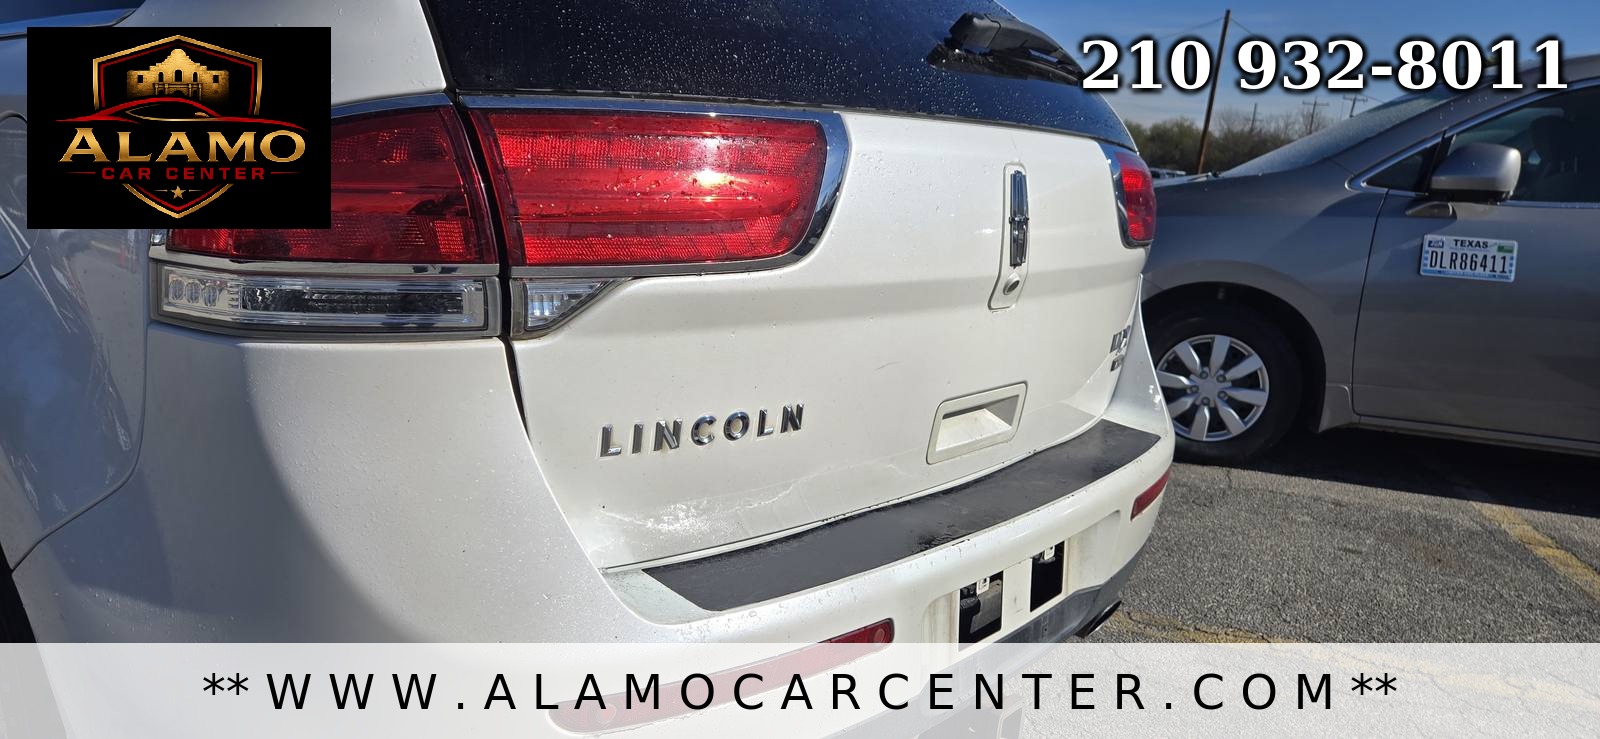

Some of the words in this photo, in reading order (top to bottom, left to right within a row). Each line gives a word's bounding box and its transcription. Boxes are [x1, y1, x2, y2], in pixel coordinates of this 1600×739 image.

[1453, 239, 1489, 249] TEXAS
[1429, 250, 1507, 274] DLR86411
[598, 403, 805, 458] LINCOLN
